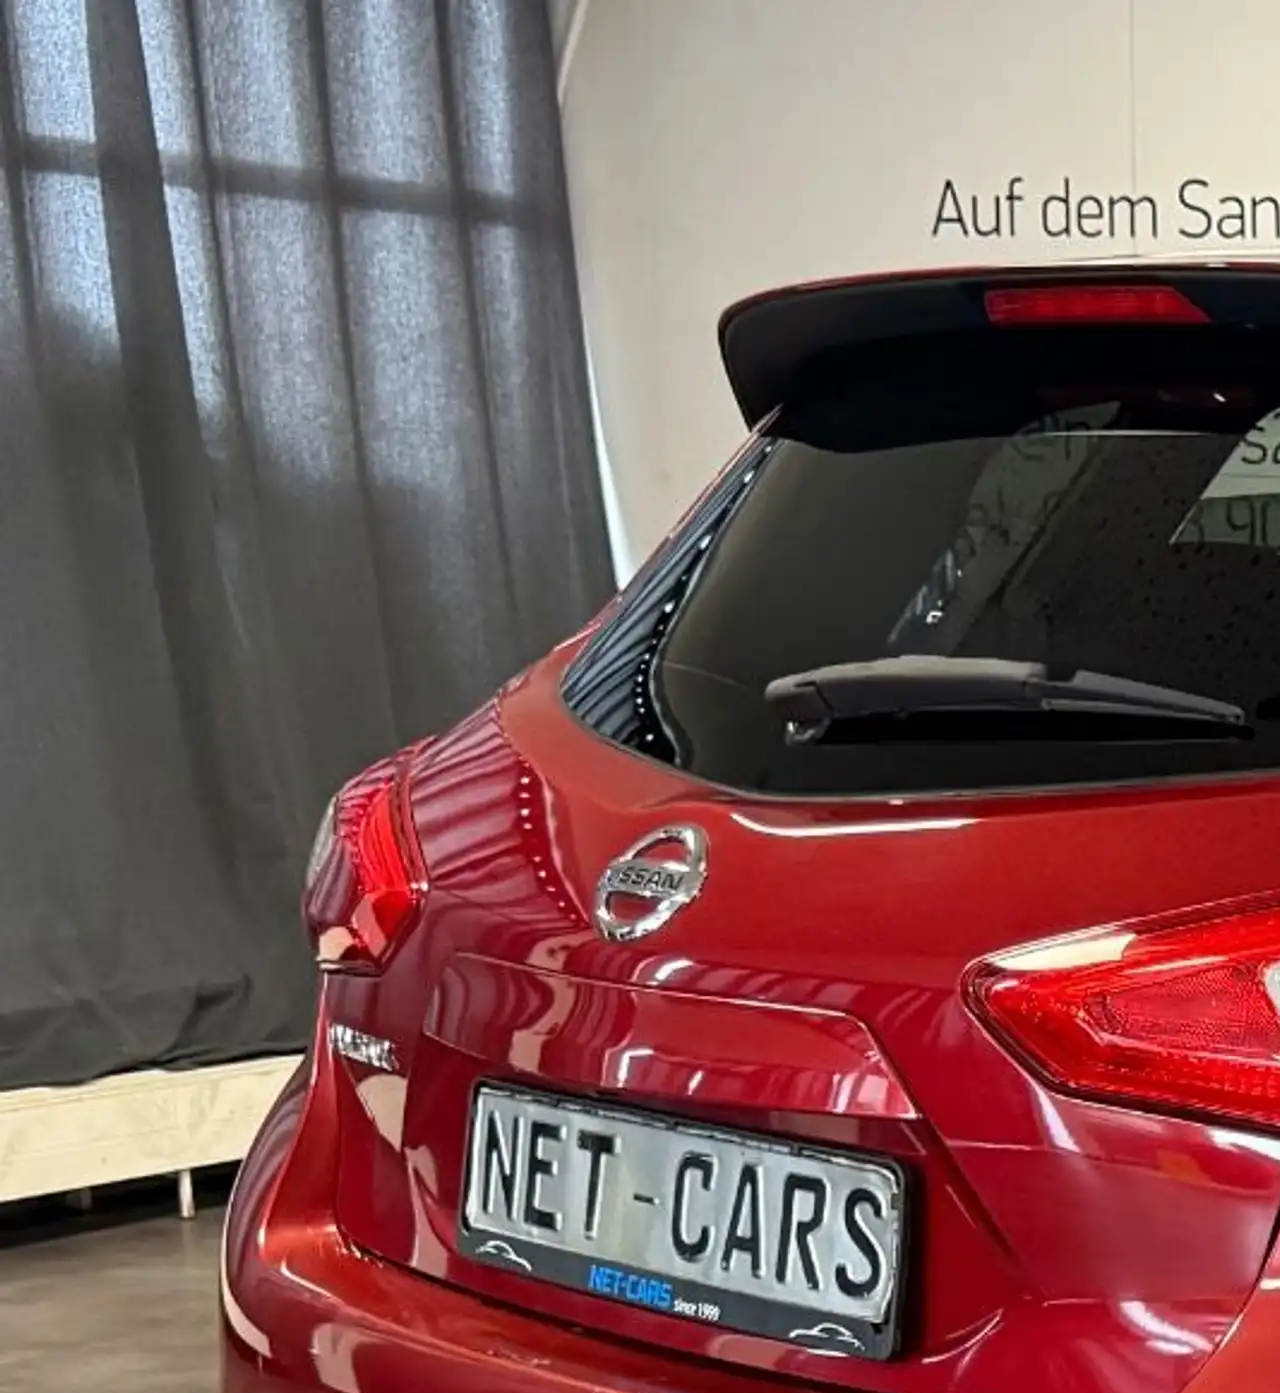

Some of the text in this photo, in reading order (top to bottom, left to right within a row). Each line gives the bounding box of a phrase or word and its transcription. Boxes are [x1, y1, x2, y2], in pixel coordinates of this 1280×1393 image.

[931, 177, 1024, 238] Auf
[1041, 178, 1159, 240] dem
[588, 1264, 674, 1308] NET-CARS
[673, 1298, 697, 1316] since
